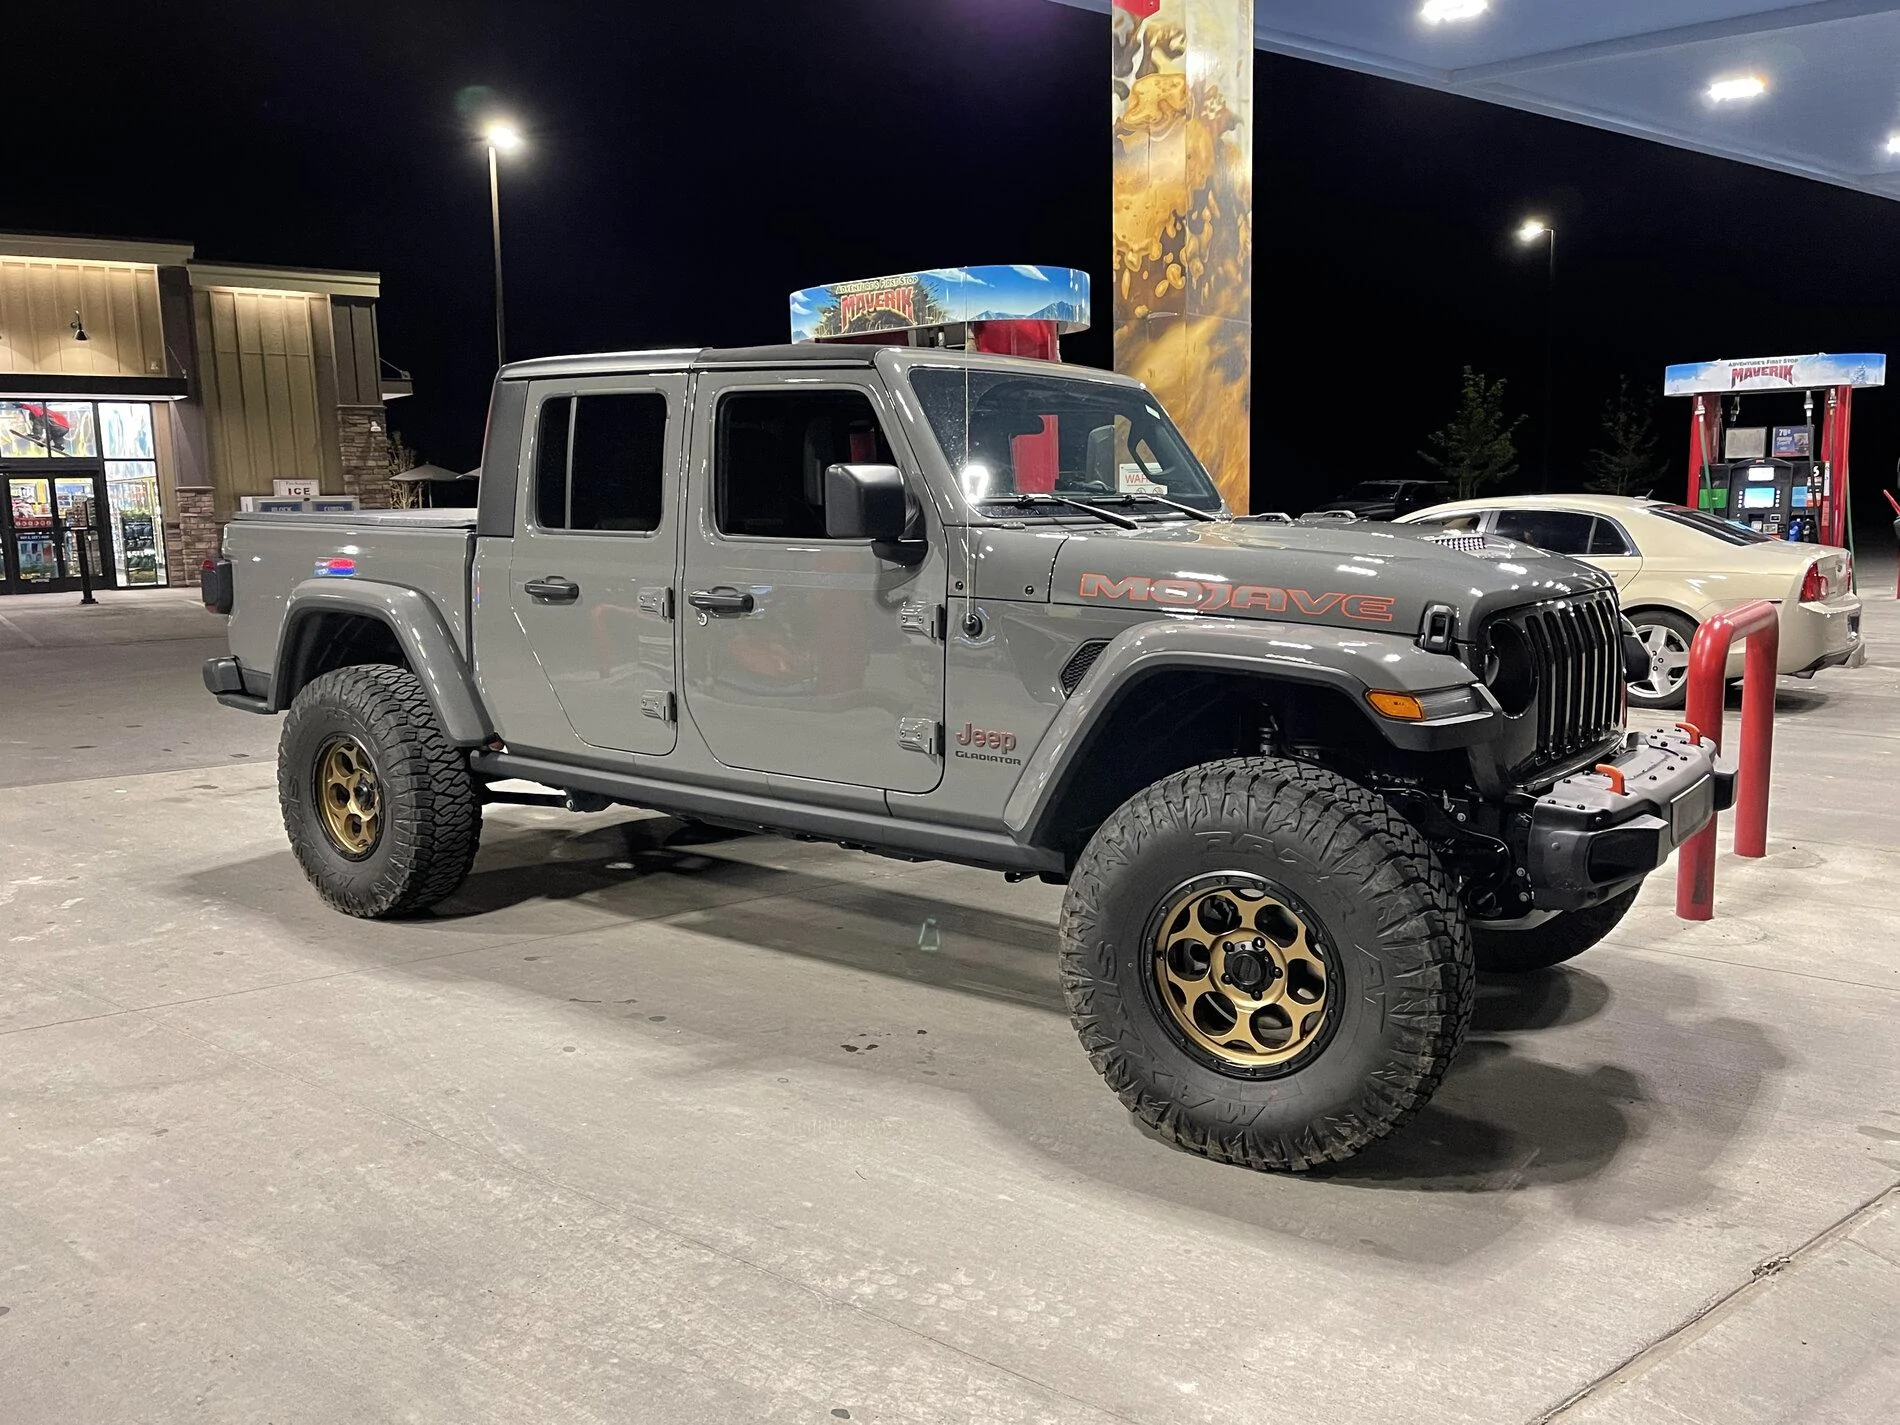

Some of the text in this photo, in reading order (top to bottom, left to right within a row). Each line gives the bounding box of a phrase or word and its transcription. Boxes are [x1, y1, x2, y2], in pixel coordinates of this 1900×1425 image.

[880, 278, 899, 290] FIRST
[899, 275, 919, 286] STOP
[841, 286, 916, 333] MAVERIK
[1731, 364, 1794, 389] MAVERIK
[288, 487, 311, 495] ICE
[1079, 573, 1395, 621] MOJAVE
[955, 721, 1016, 755] Jeep
[955, 750, 1022, 766] GLADIATOR
